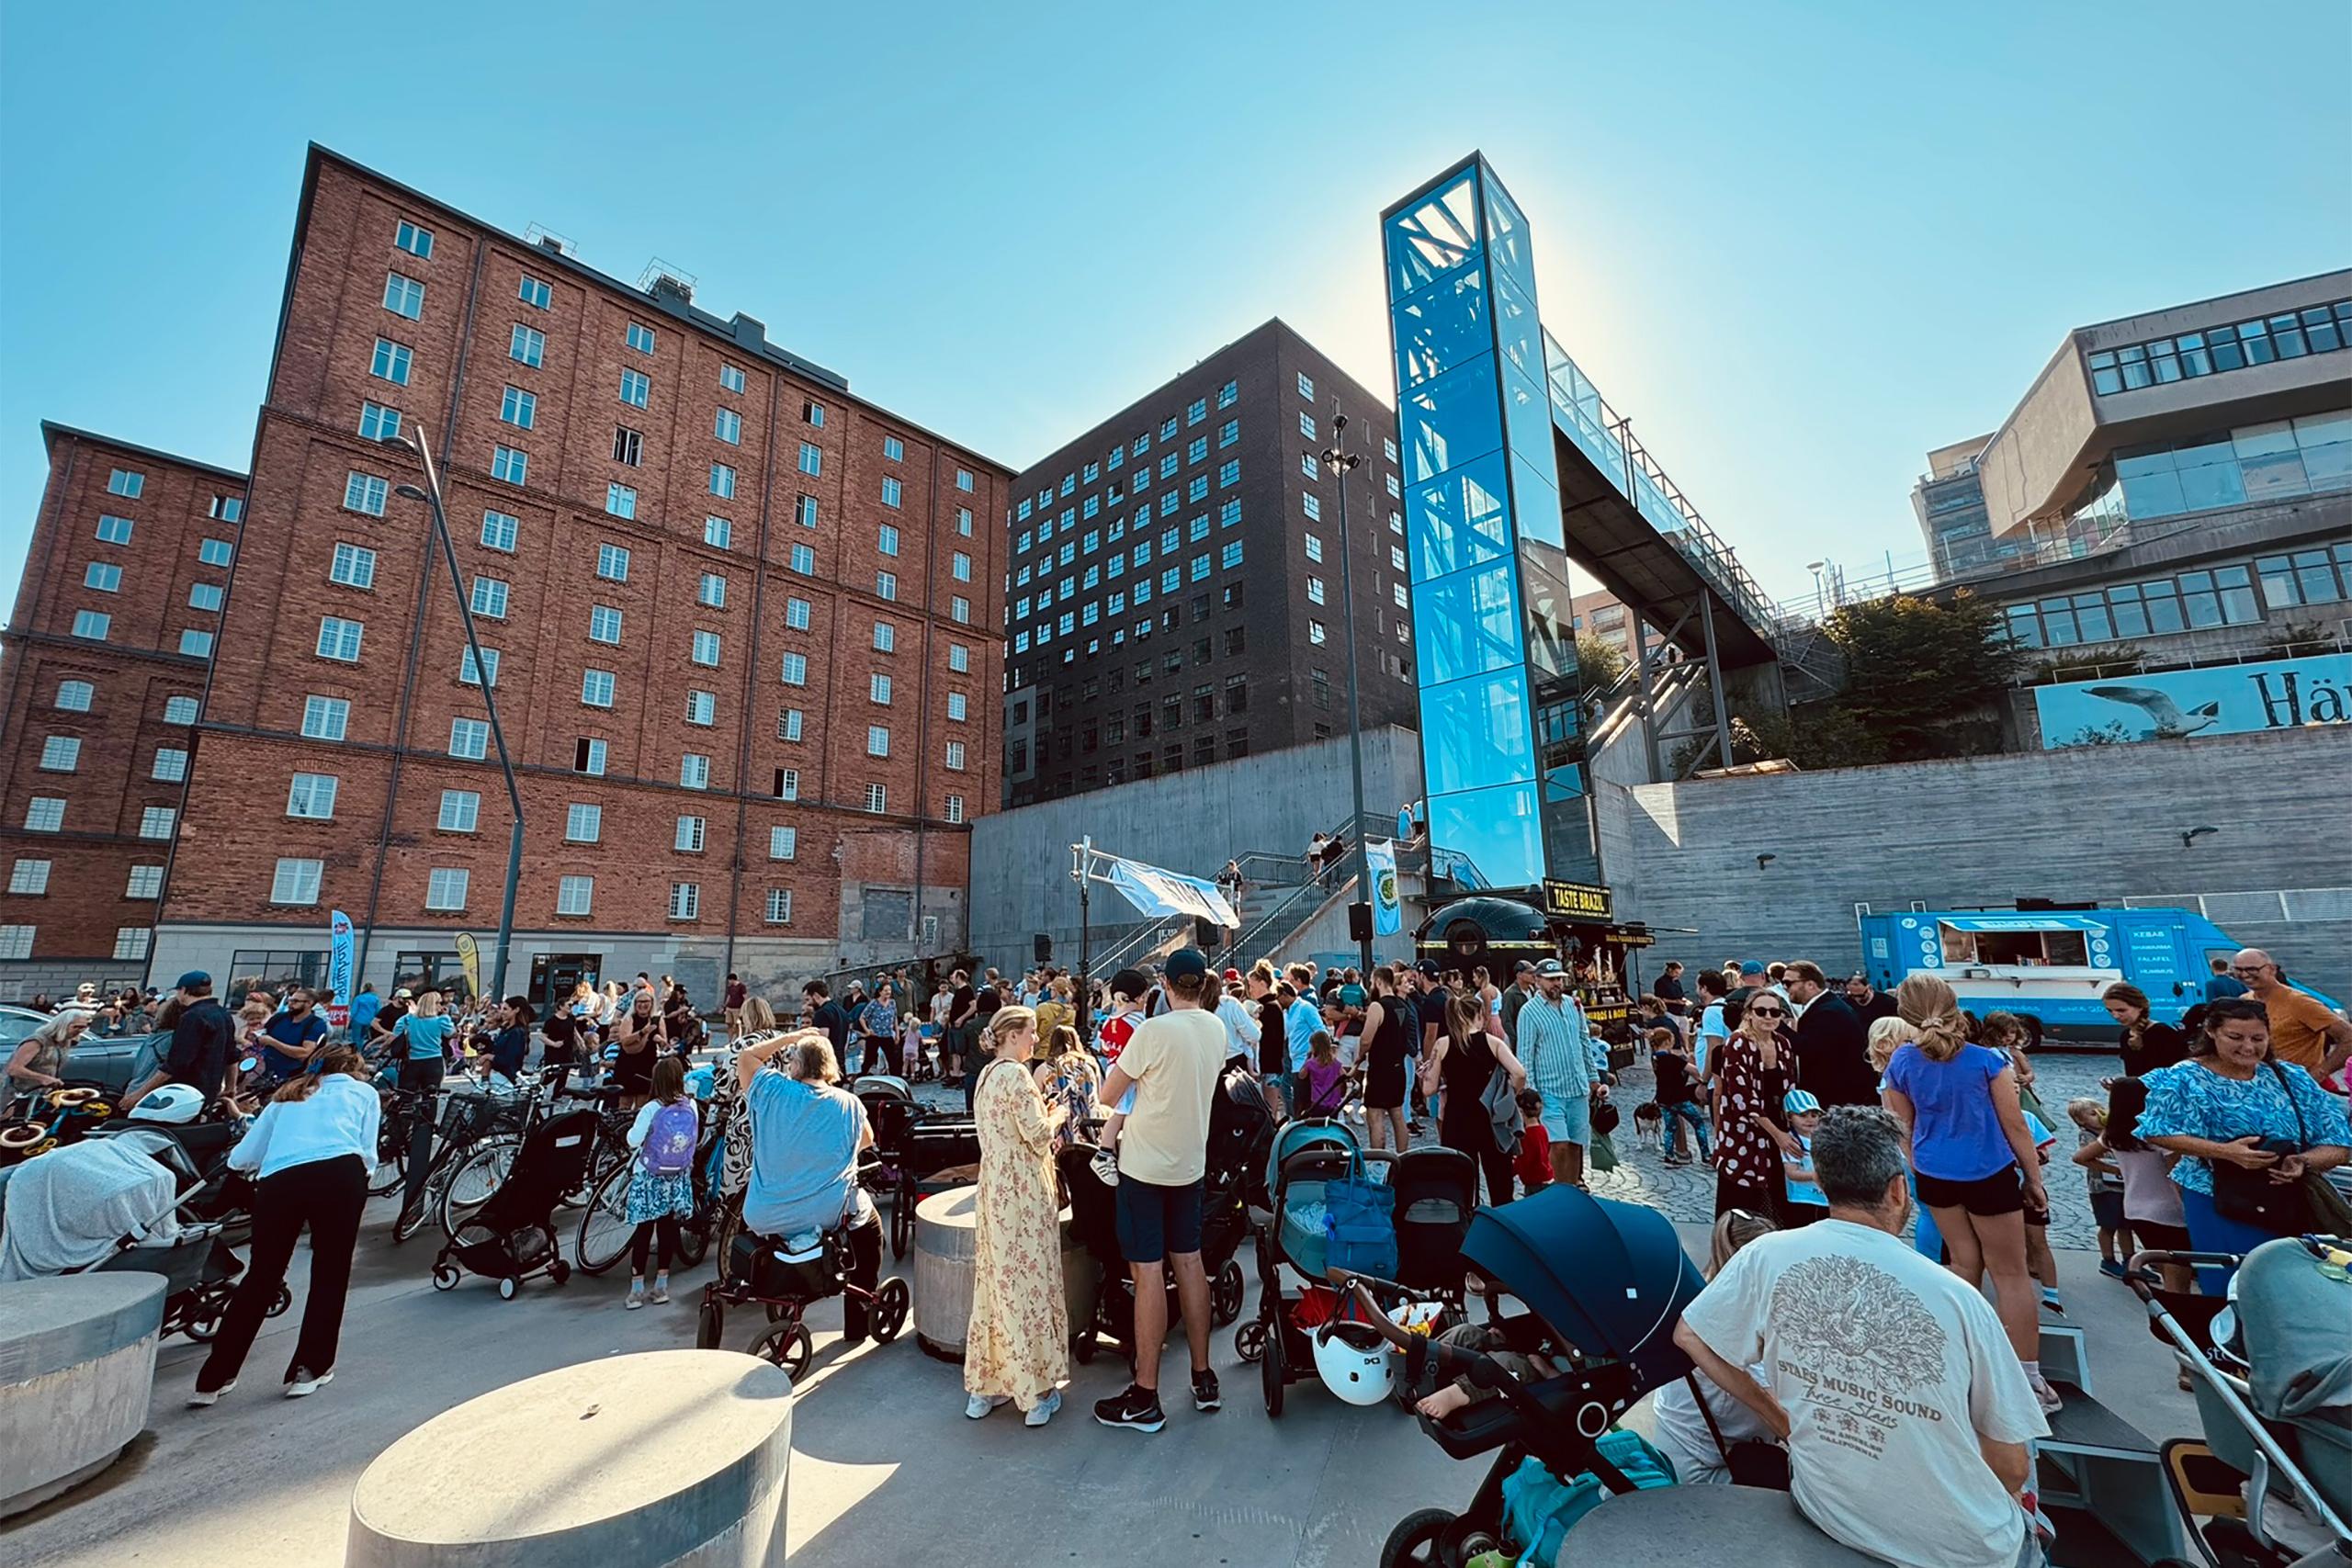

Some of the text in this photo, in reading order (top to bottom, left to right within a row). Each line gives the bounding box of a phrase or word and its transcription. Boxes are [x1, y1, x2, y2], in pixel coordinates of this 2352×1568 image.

[1554, 888, 1605, 912] TASTE BRAZIL
[1823, 1375, 1877, 1404] MUSIC
[1882, 1395, 1942, 1422] SOUND
[1819, 1434, 1881, 1461] CALIFORNIA
